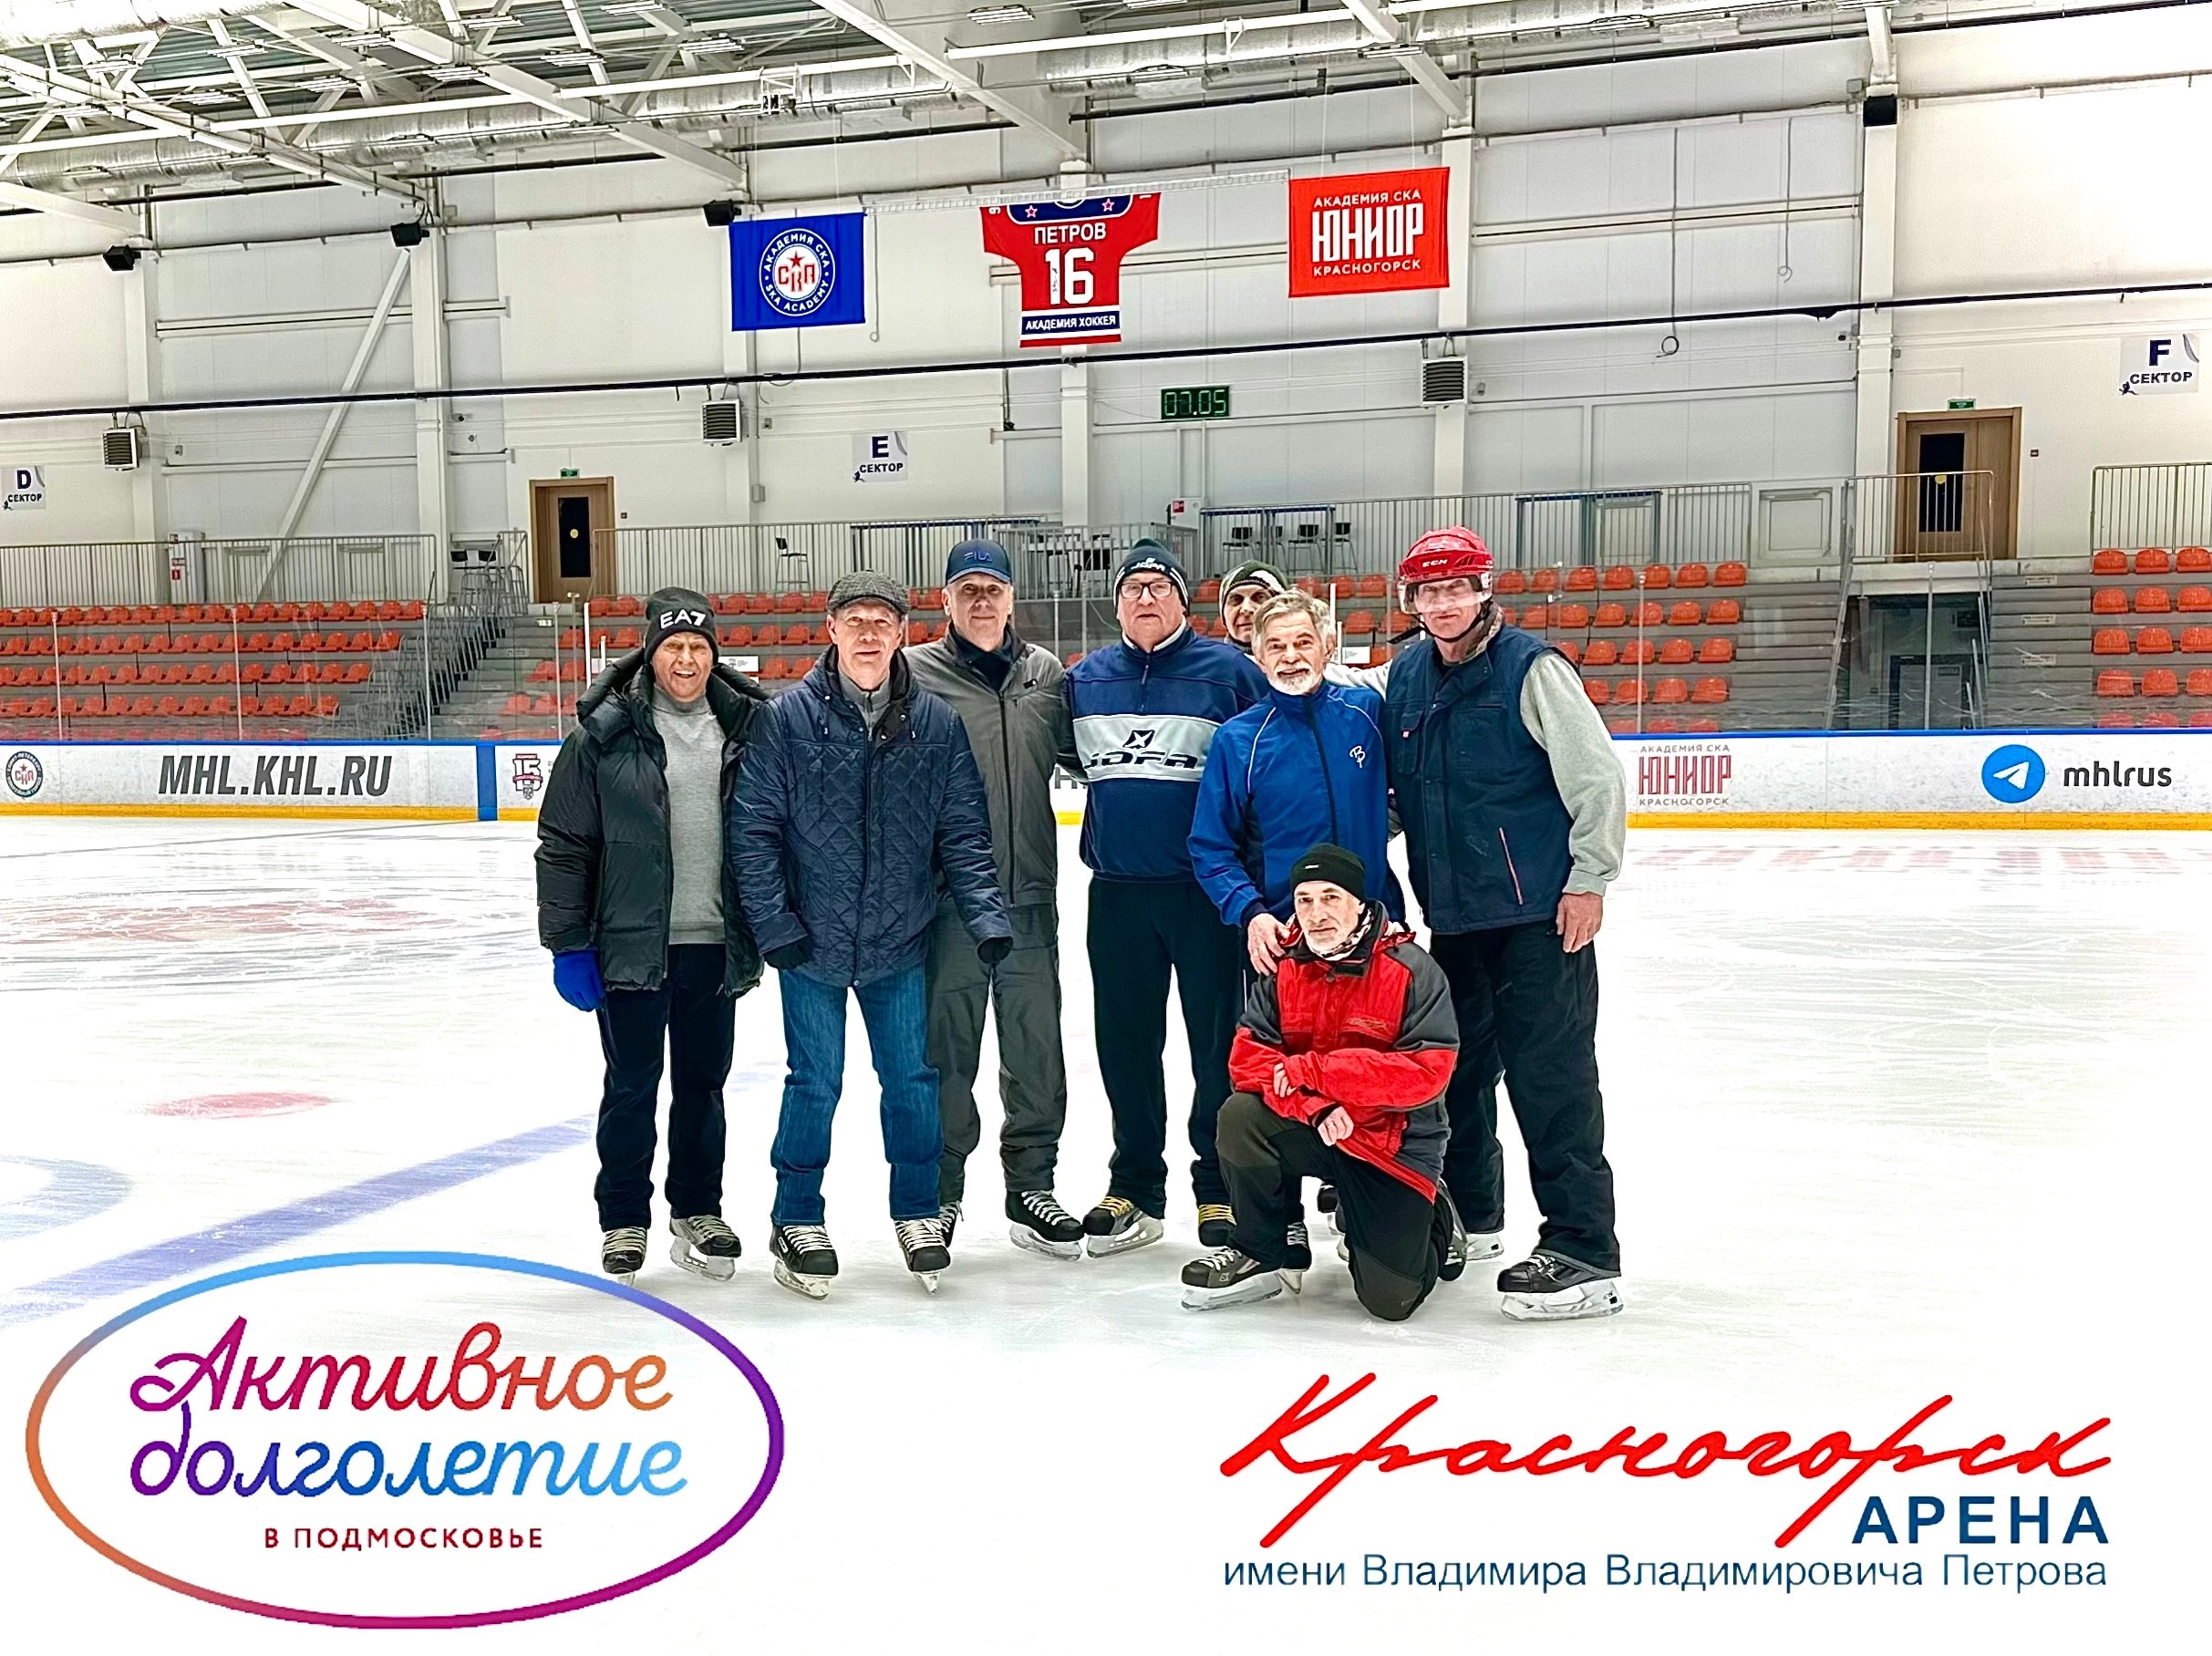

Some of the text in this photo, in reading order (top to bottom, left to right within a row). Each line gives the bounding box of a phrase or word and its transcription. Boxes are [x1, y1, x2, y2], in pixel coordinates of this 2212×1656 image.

[1314, 189, 1421, 208] АКАДЕМИЯ СКА
[1034, 222, 1106, 244] ПЕТРОВ
[1312, 202, 1424, 263] ЮНИОР
[763, 233, 831, 273] АКАДЕМИЯ СКА
[1045, 247, 1094, 305] 16
[1313, 258, 1421, 277] КРАСНОГОРСК
[765, 279, 829, 312] SKA ACADEMY
[1026, 315, 1116, 331] АКАДЕМИЯ ХОККЕЯ
[2149, 338, 2172, 366] F
[2129, 371, 2193, 384] СЕКТОР
[872, 435, 890, 459] E
[859, 462, 904, 473] СЕКТОР
[16, 470, 32, 490] D
[7, 493, 43, 502] СЕКТОР
[964, 550, 992, 563] FILA
[660, 608, 707, 629] EA7
[1640, 744, 1731, 753] АКАДЕМИЯ СКА
[158, 755, 393, 797] MHL.KHL.RU
[1638, 755, 1731, 795] ЮНИОР
[2063, 761, 2172, 787] mhlrus
[1639, 798, 1729, 806] КРАСНОГОРСК
